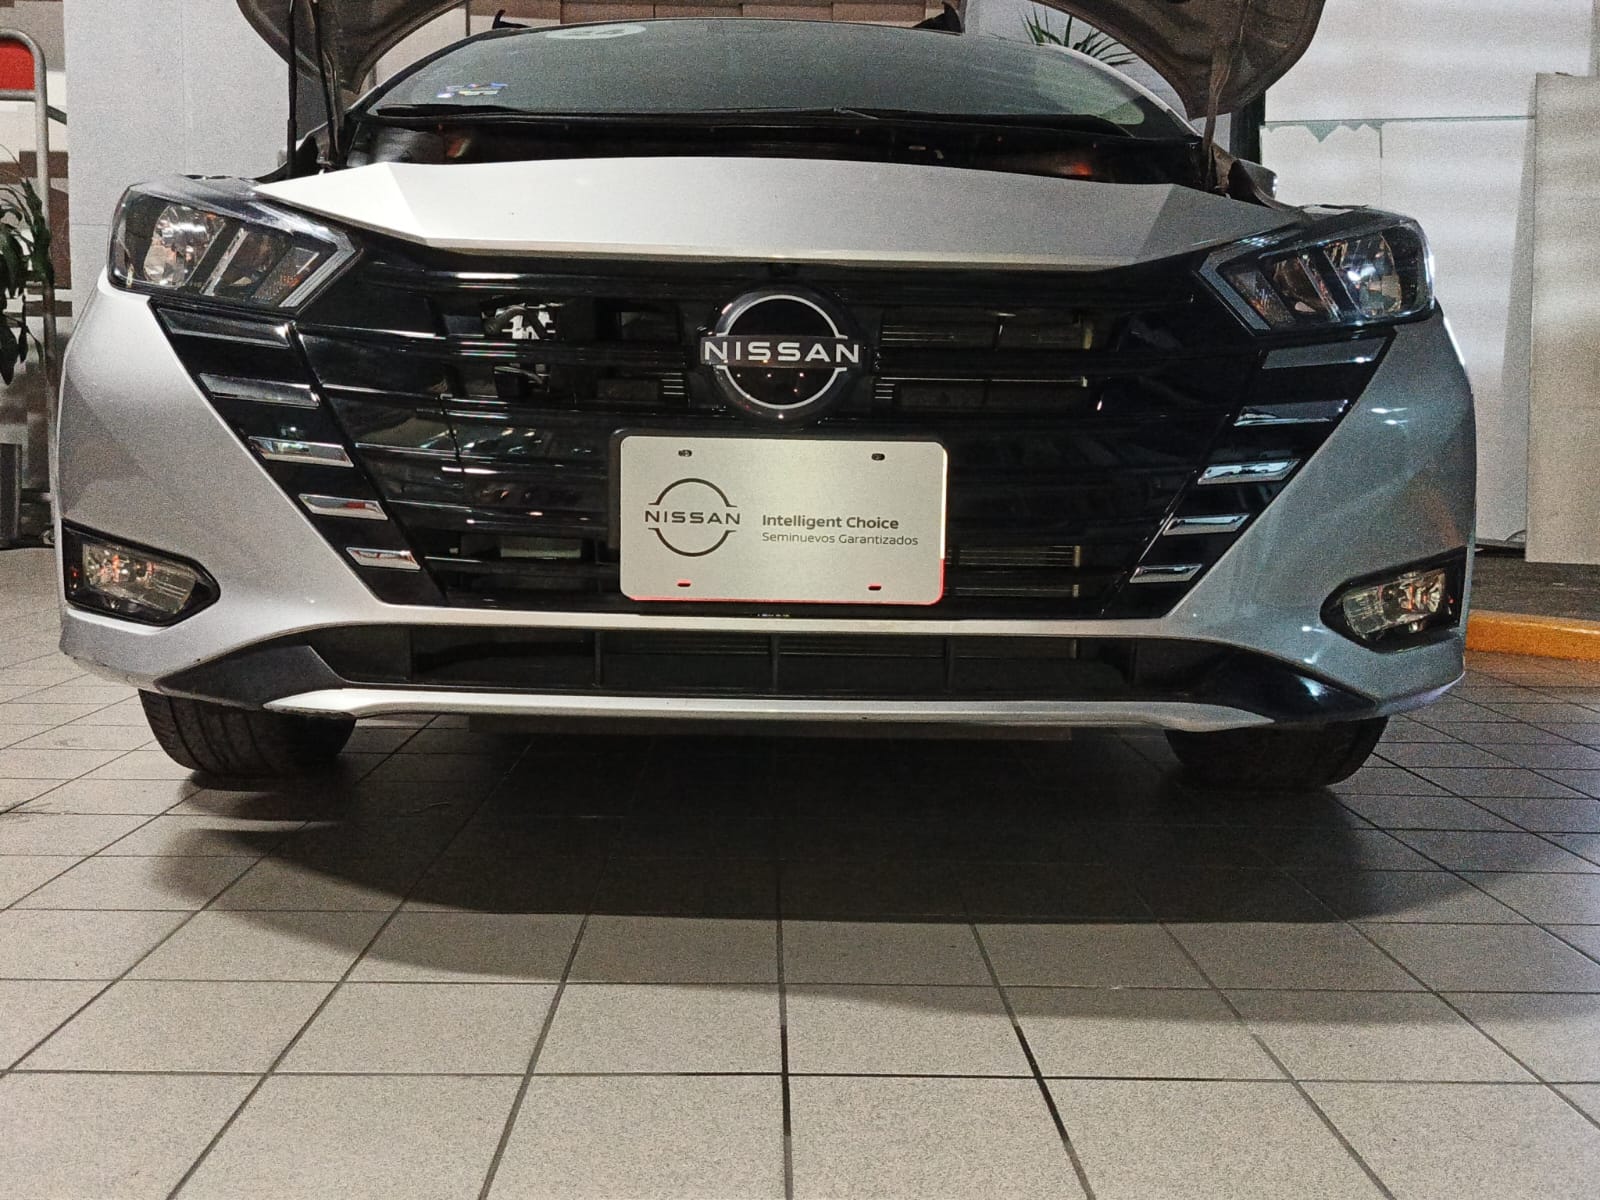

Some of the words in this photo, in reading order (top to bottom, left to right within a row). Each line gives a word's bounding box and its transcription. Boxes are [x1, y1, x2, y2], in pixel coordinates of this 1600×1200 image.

[704, 341, 860, 363] NISSAN
[645, 511, 741, 525] NISSAN
[762, 514, 842, 530] Intelligent
[846, 516, 899, 530] Choice
[762, 532, 835, 544] Seminuevos
[838, 534, 919, 546] Garantizados
